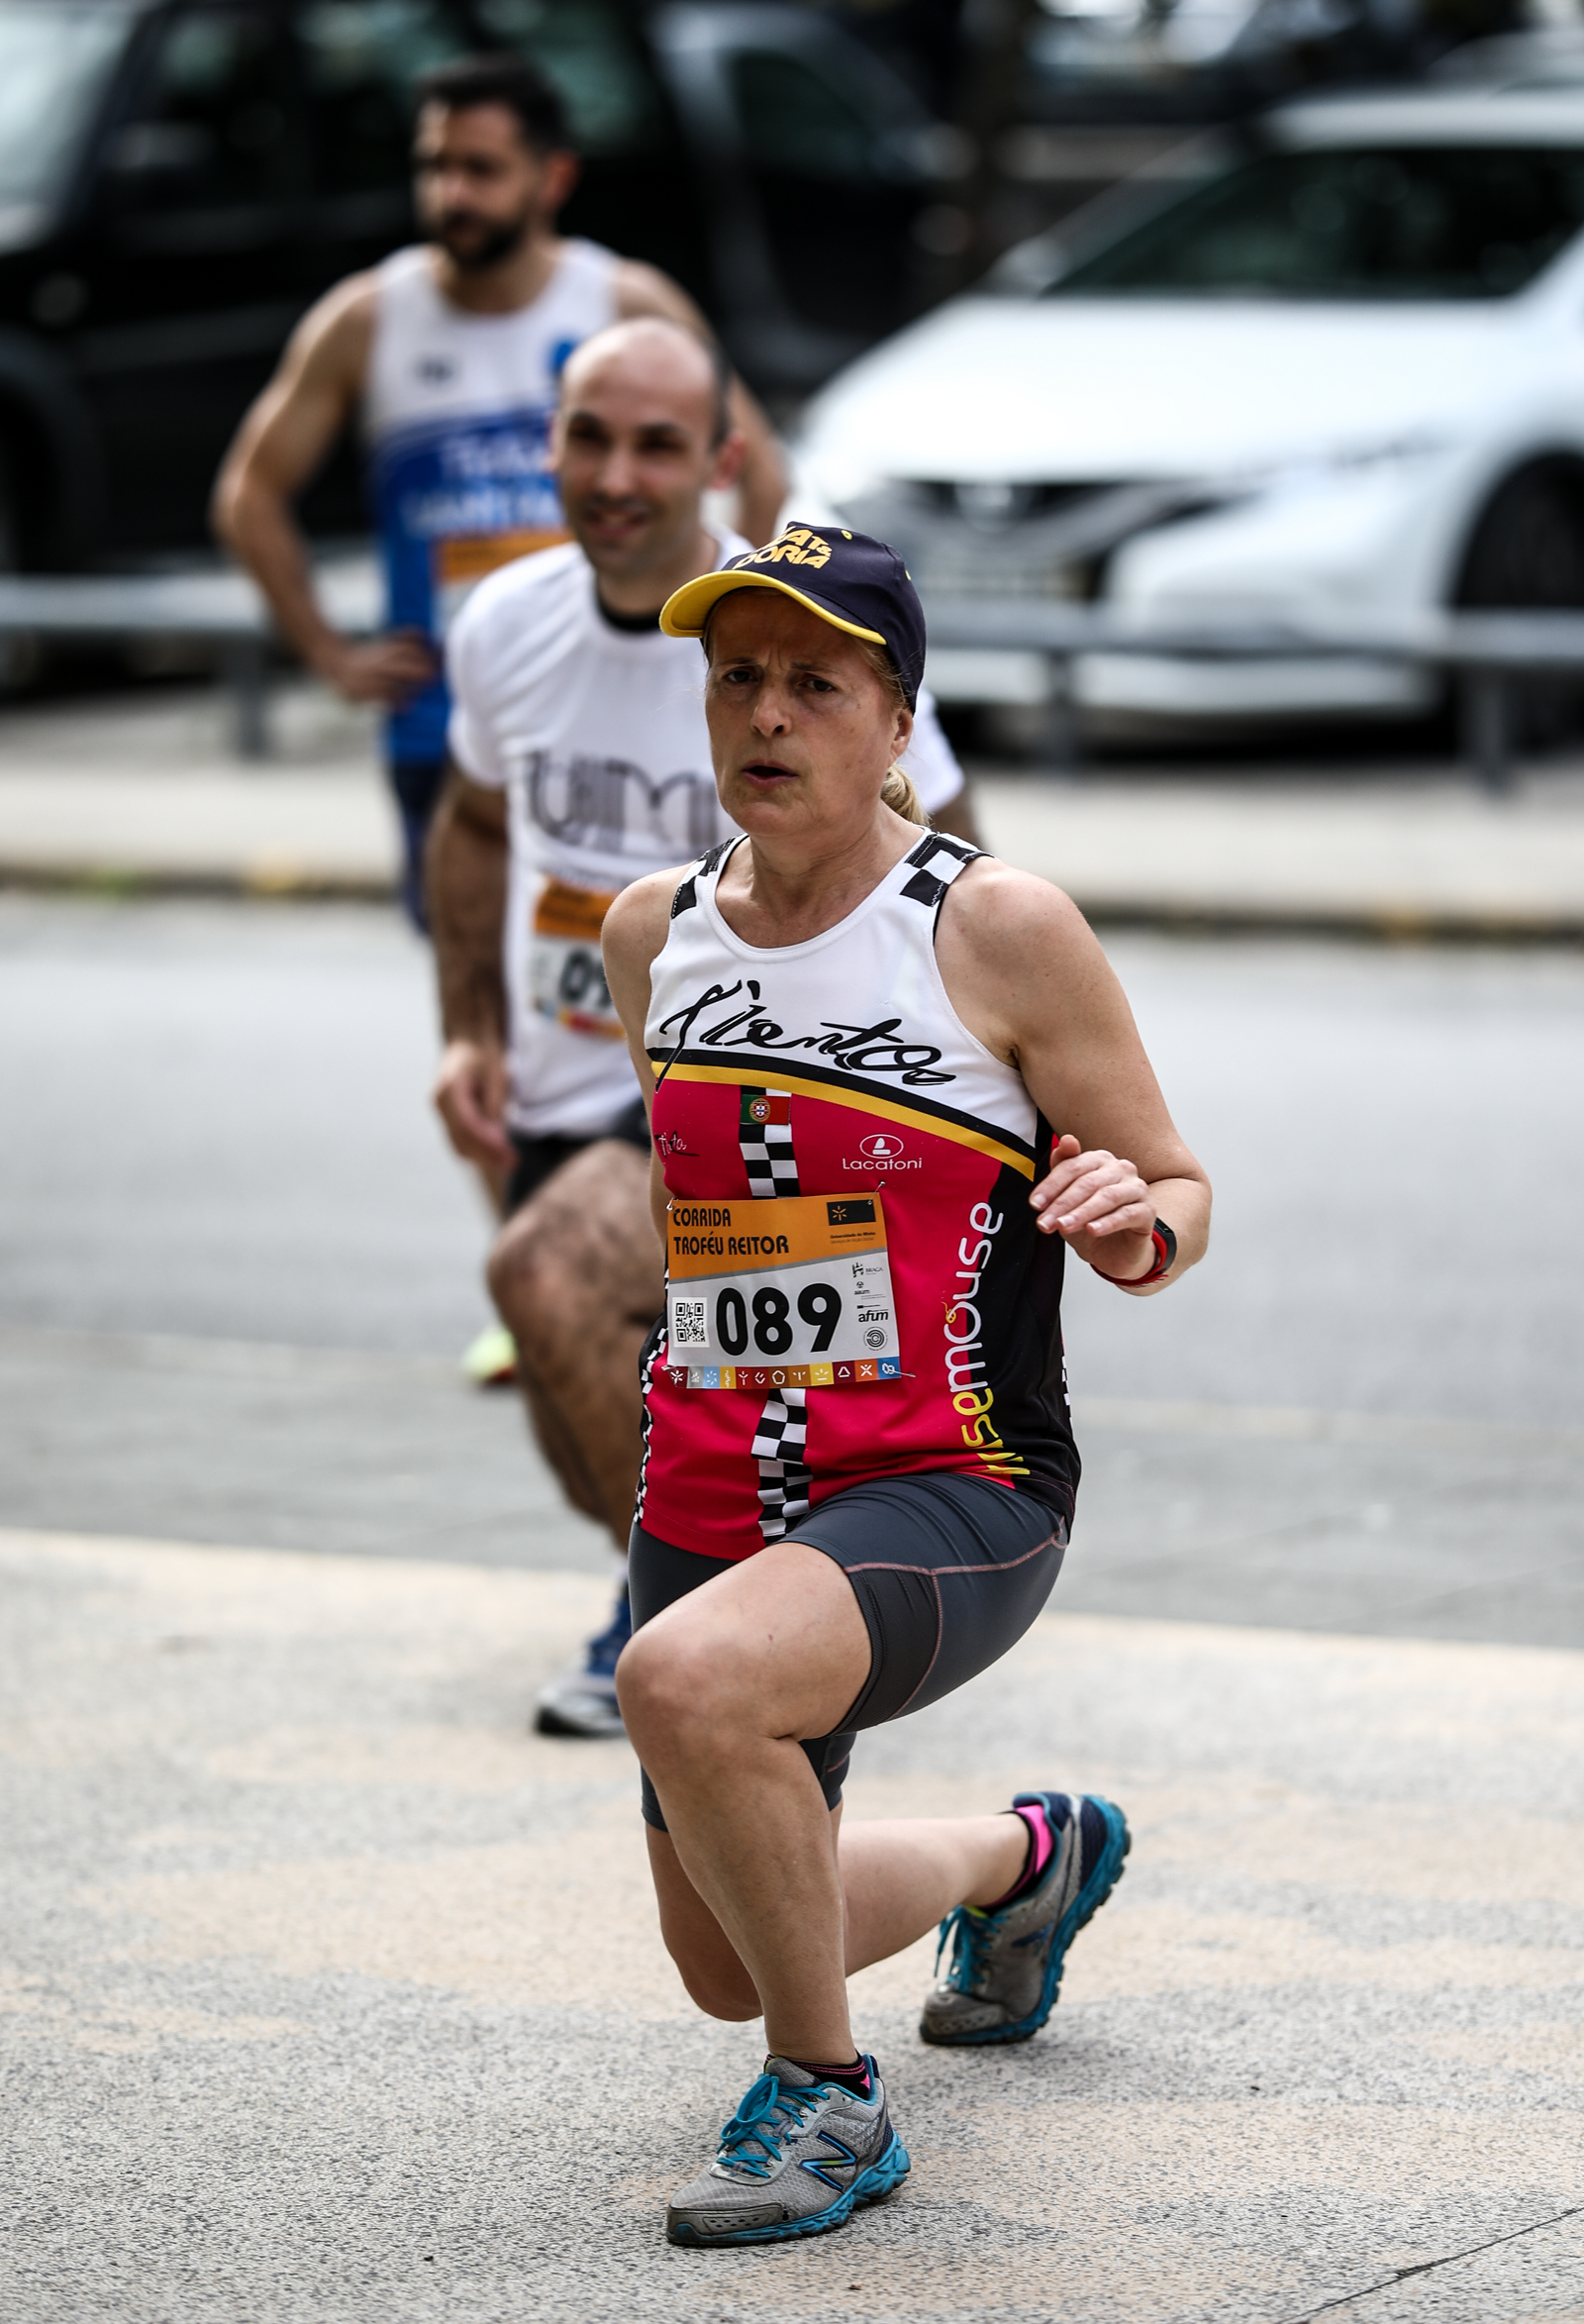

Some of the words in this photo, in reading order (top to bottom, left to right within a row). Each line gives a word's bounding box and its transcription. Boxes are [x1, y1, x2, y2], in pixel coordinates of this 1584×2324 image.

[842, 1157, 923, 1170] Lacatoni
[672, 1207, 732, 1227] CORRIDA
[673, 1230, 724, 1256] TROFÉU
[728, 1234, 789, 1256] REITOR
[716, 1282, 842, 1357] 089
